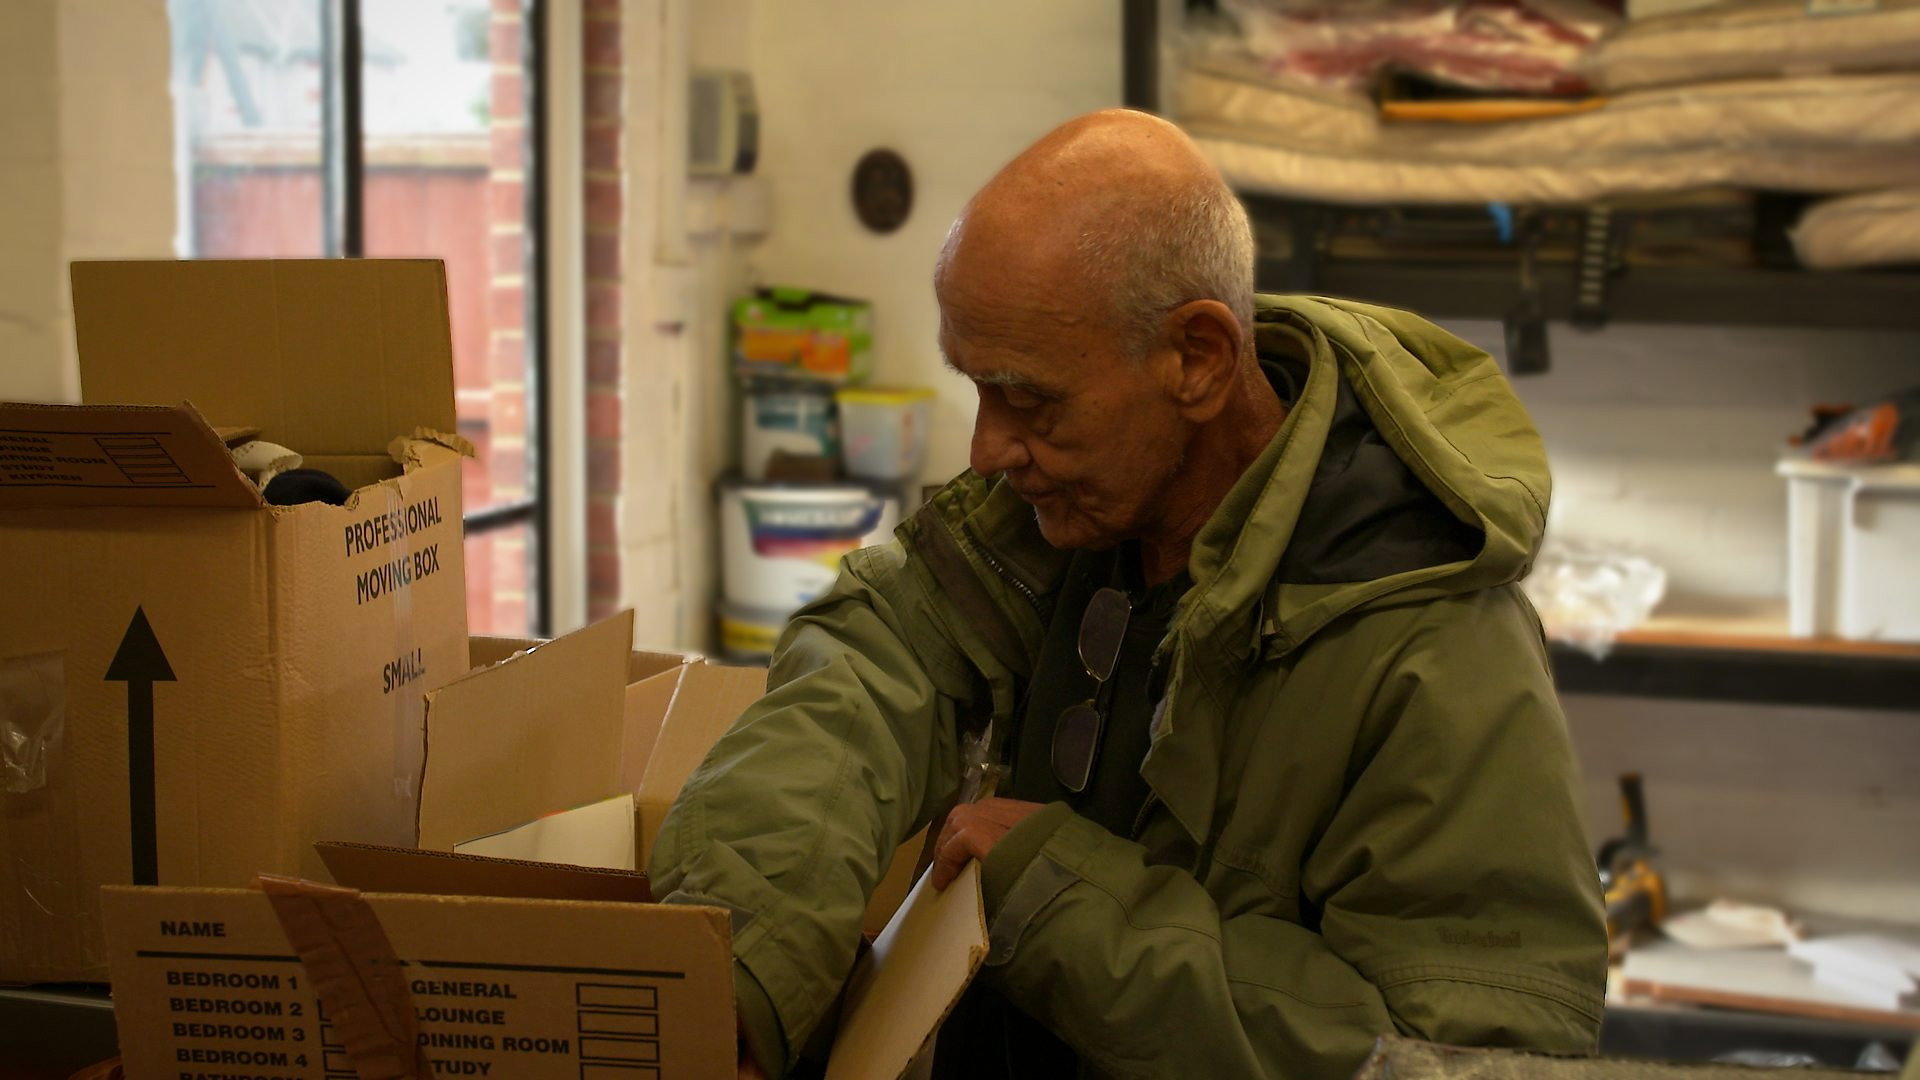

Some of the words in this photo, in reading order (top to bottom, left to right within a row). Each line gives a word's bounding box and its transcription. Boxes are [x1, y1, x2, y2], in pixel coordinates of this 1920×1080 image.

[55, 456, 108, 464] ROOM
[8, 473, 83, 481] KITCHEN
[345, 496, 442, 557] PROFESSIONAL
[357, 555, 411, 604] MOVING
[414, 543, 440, 581] BOX
[383, 648, 425, 694] SMALL
[160, 921, 226, 937] NAME
[167, 971, 279, 989] BEDROOM
[288, 976, 297, 989] 1
[411, 980, 517, 999] GENERAL
[170, 998, 282, 1016] BEDROOM
[289, 1003, 303, 1016] 2
[173, 1023, 285, 1041] BEDROOM
[292, 1028, 305, 1042] 3
[416, 1032, 495, 1050] DINING
[503, 1037, 569, 1054] ROOM
[176, 1048, 288, 1067] BEDROOM
[295, 1054, 308, 1067] 4
[431, 1059, 492, 1076] TUDY
